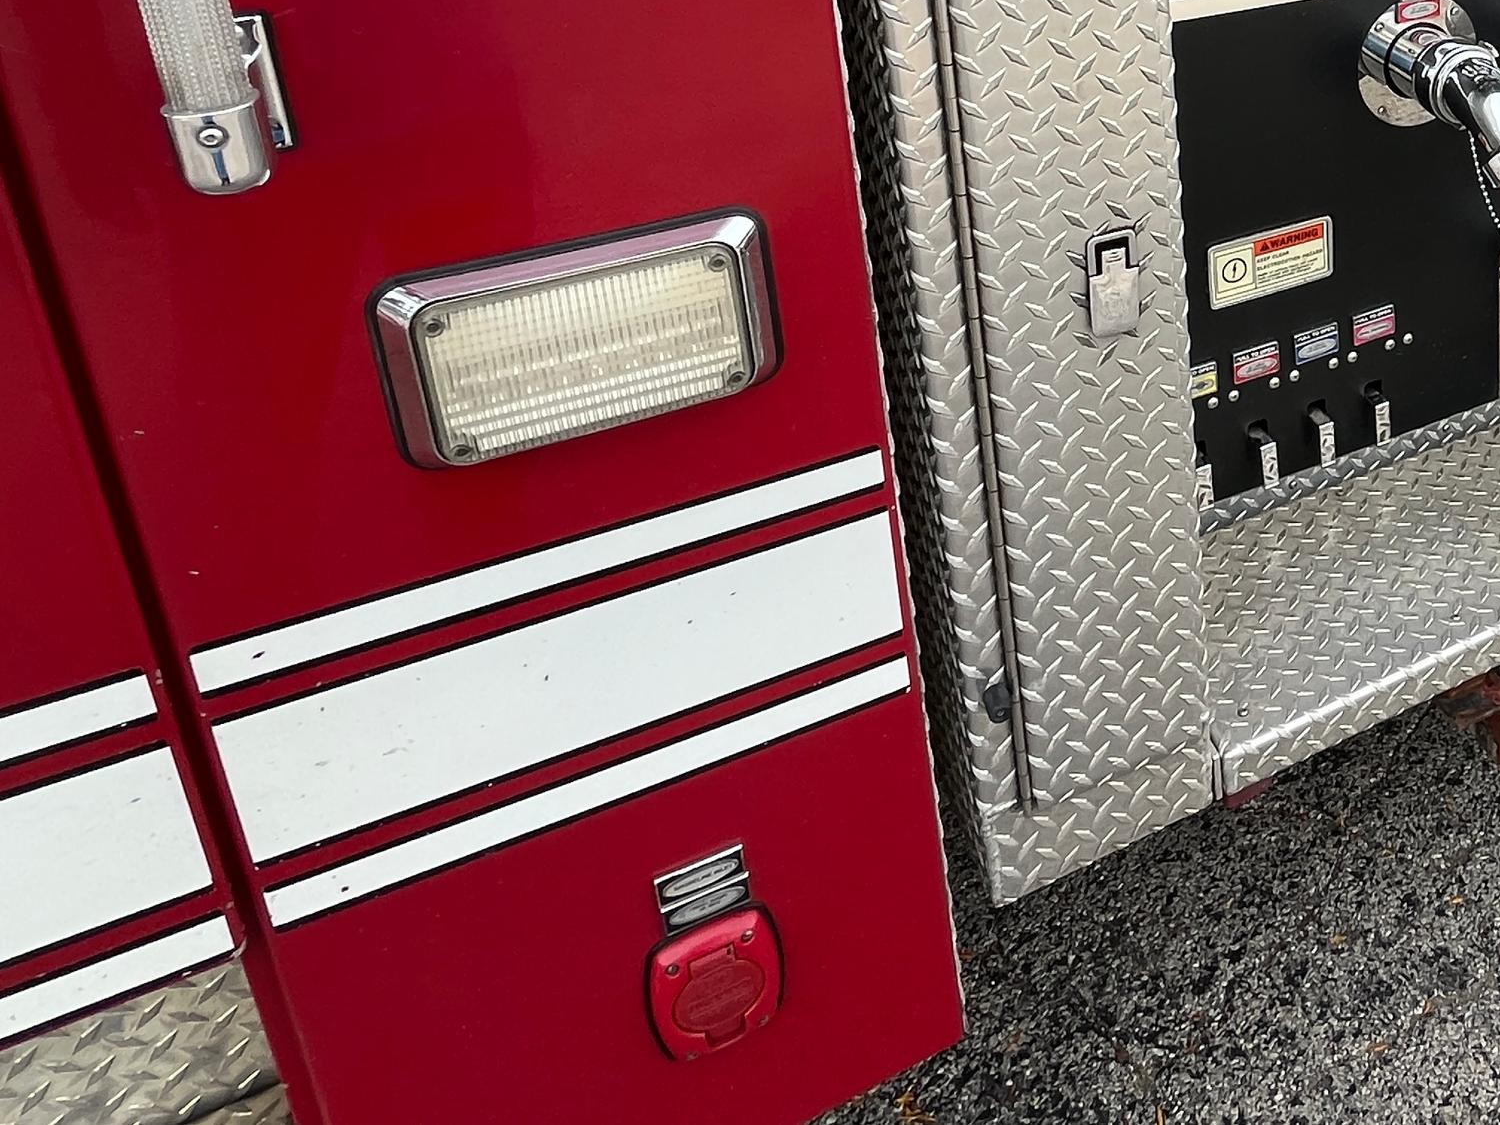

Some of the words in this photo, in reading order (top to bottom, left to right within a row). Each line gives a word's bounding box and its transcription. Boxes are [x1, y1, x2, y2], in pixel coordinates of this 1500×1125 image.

[1270, 228, 1318, 248] WARNING
[1257, 255, 1270, 263] KEEP
[1272, 251, 1289, 259] CLEAR
[1257, 255, 1300, 271] ELECTROCUTION
[1302, 248, 1323, 258] HAZARD
[1260, 346, 1276, 356] OPEN
[1198, 365, 1214, 373] OPEN
